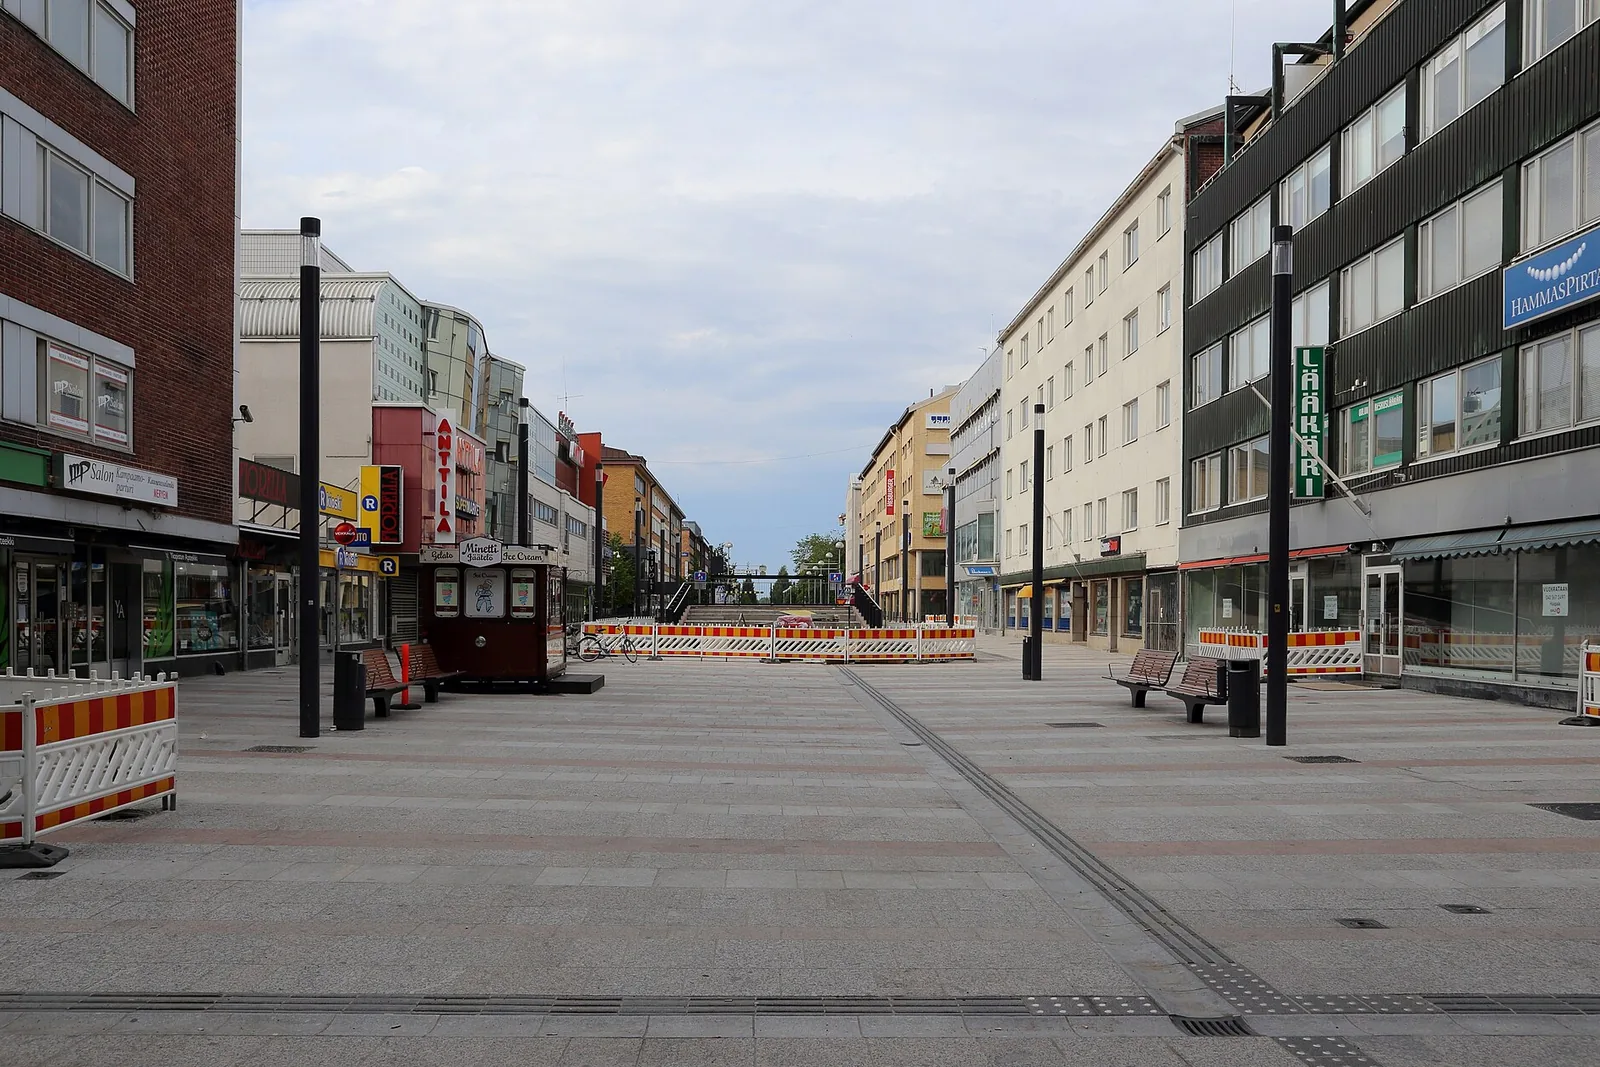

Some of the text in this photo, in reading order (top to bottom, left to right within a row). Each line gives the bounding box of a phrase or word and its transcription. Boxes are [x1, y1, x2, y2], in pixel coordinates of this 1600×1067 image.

[1300, 349, 1321, 496] LÄÄKÄRI
[90, 463, 114, 484] Salon
[239, 461, 288, 503] FIORELLA
[436, 417, 452, 533] ANTTILA
[326, 491, 343, 512] kioski
[886, 477, 895, 507] HESBURGER
[365, 498, 376, 509] R
[380, 471, 398, 542] FIORELLA
[431, 550, 454, 562] Gelato
[462, 542, 499, 555] Minetti
[467, 553, 494, 563] Jäätelö
[502, 551, 544, 562] Ice Cream
[383, 561, 394, 573] R
